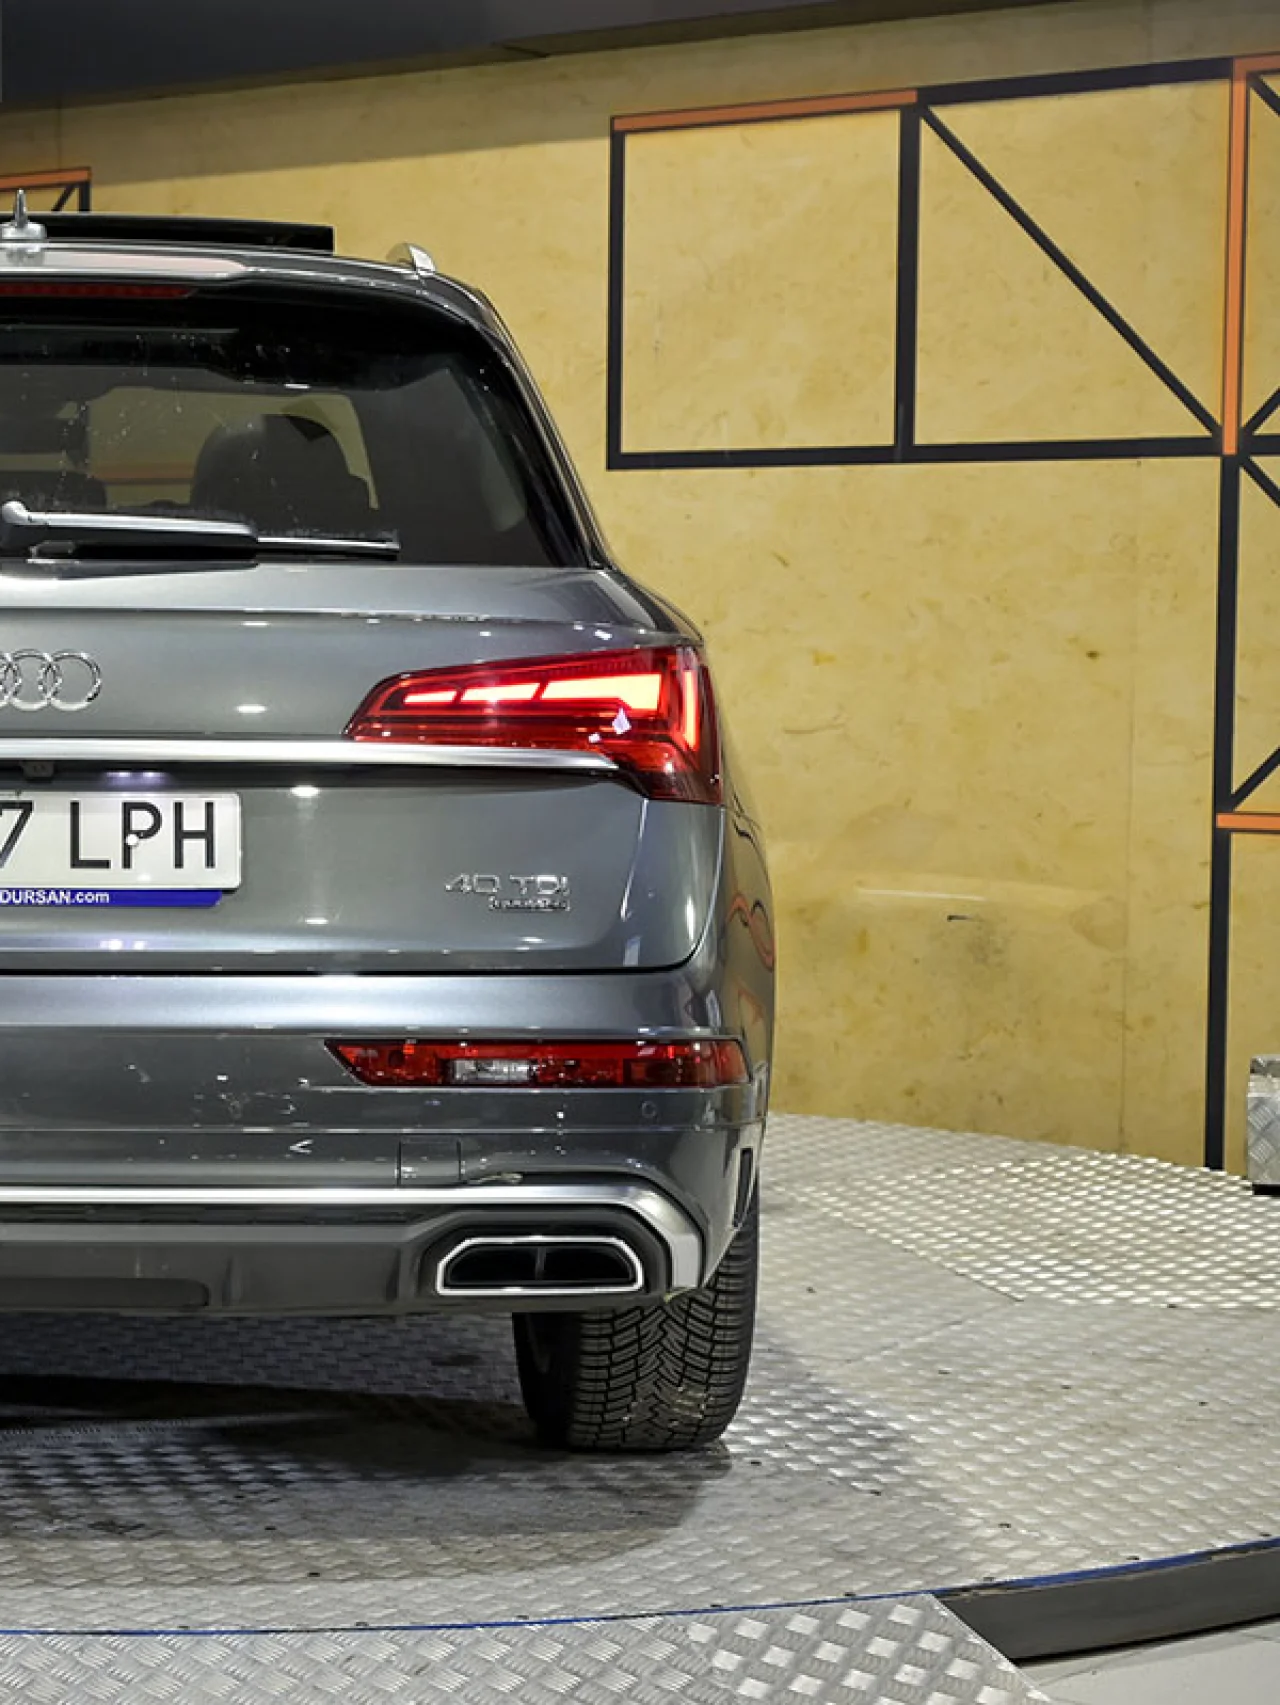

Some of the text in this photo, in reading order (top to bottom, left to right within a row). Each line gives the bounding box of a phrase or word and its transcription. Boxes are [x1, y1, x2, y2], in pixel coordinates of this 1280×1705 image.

[69, 801, 216, 870] LPH
[445, 873, 570, 896] 40 TDI
[0, 889, 110, 904] DURSAN.com
